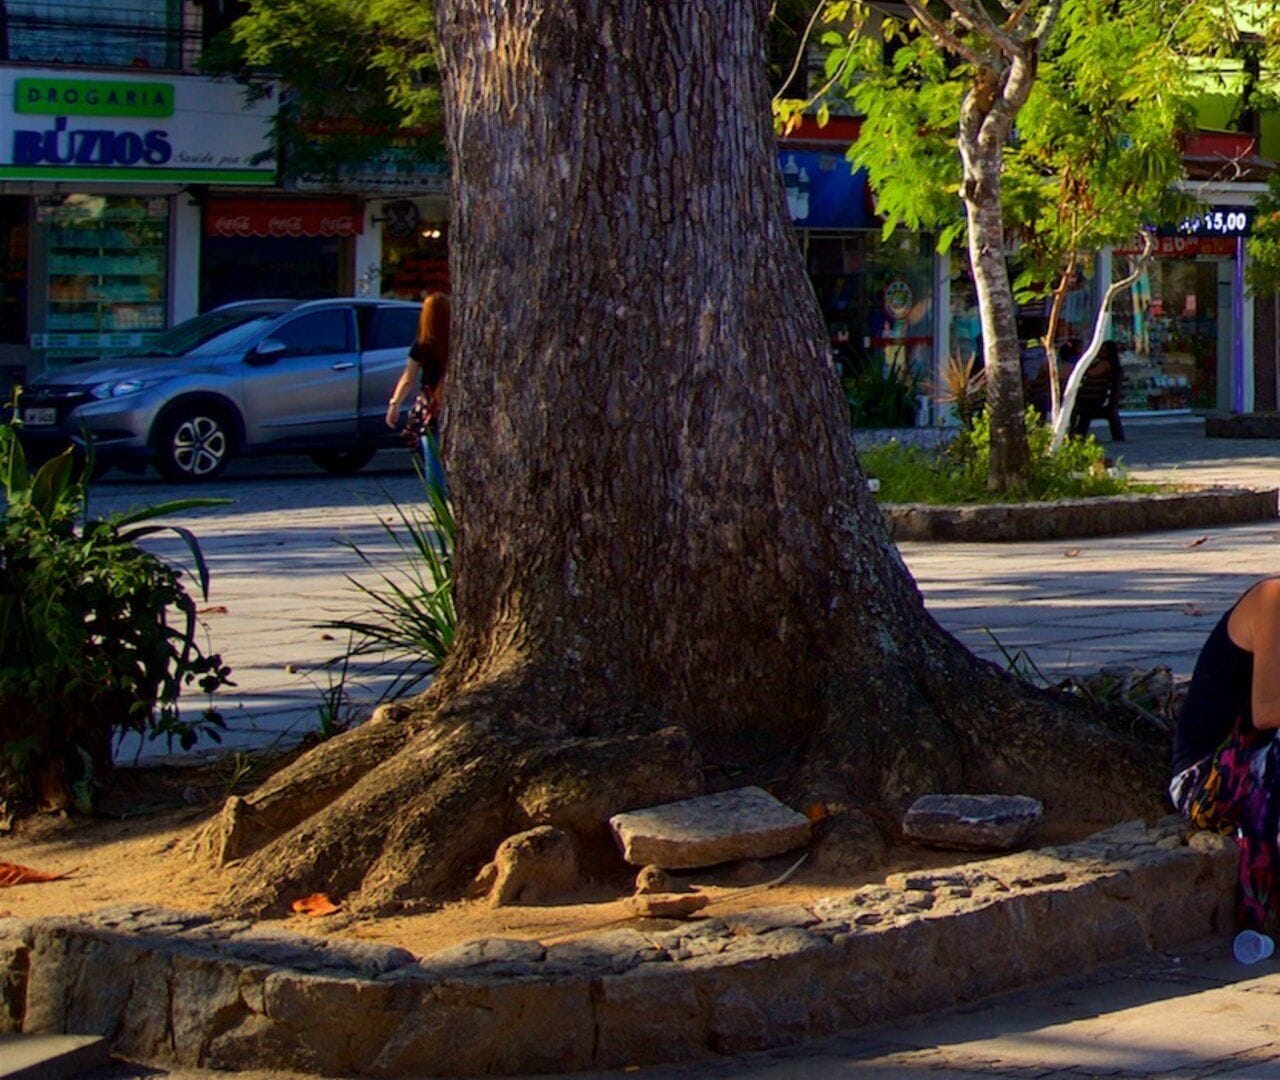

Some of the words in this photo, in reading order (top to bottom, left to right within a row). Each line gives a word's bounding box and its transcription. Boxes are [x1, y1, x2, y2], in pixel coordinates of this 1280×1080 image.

[28, 88, 166, 107] DROGARIA
[12, 117, 173, 165] BÚZIOS
[1204, 212, 1247, 233] 15,00
